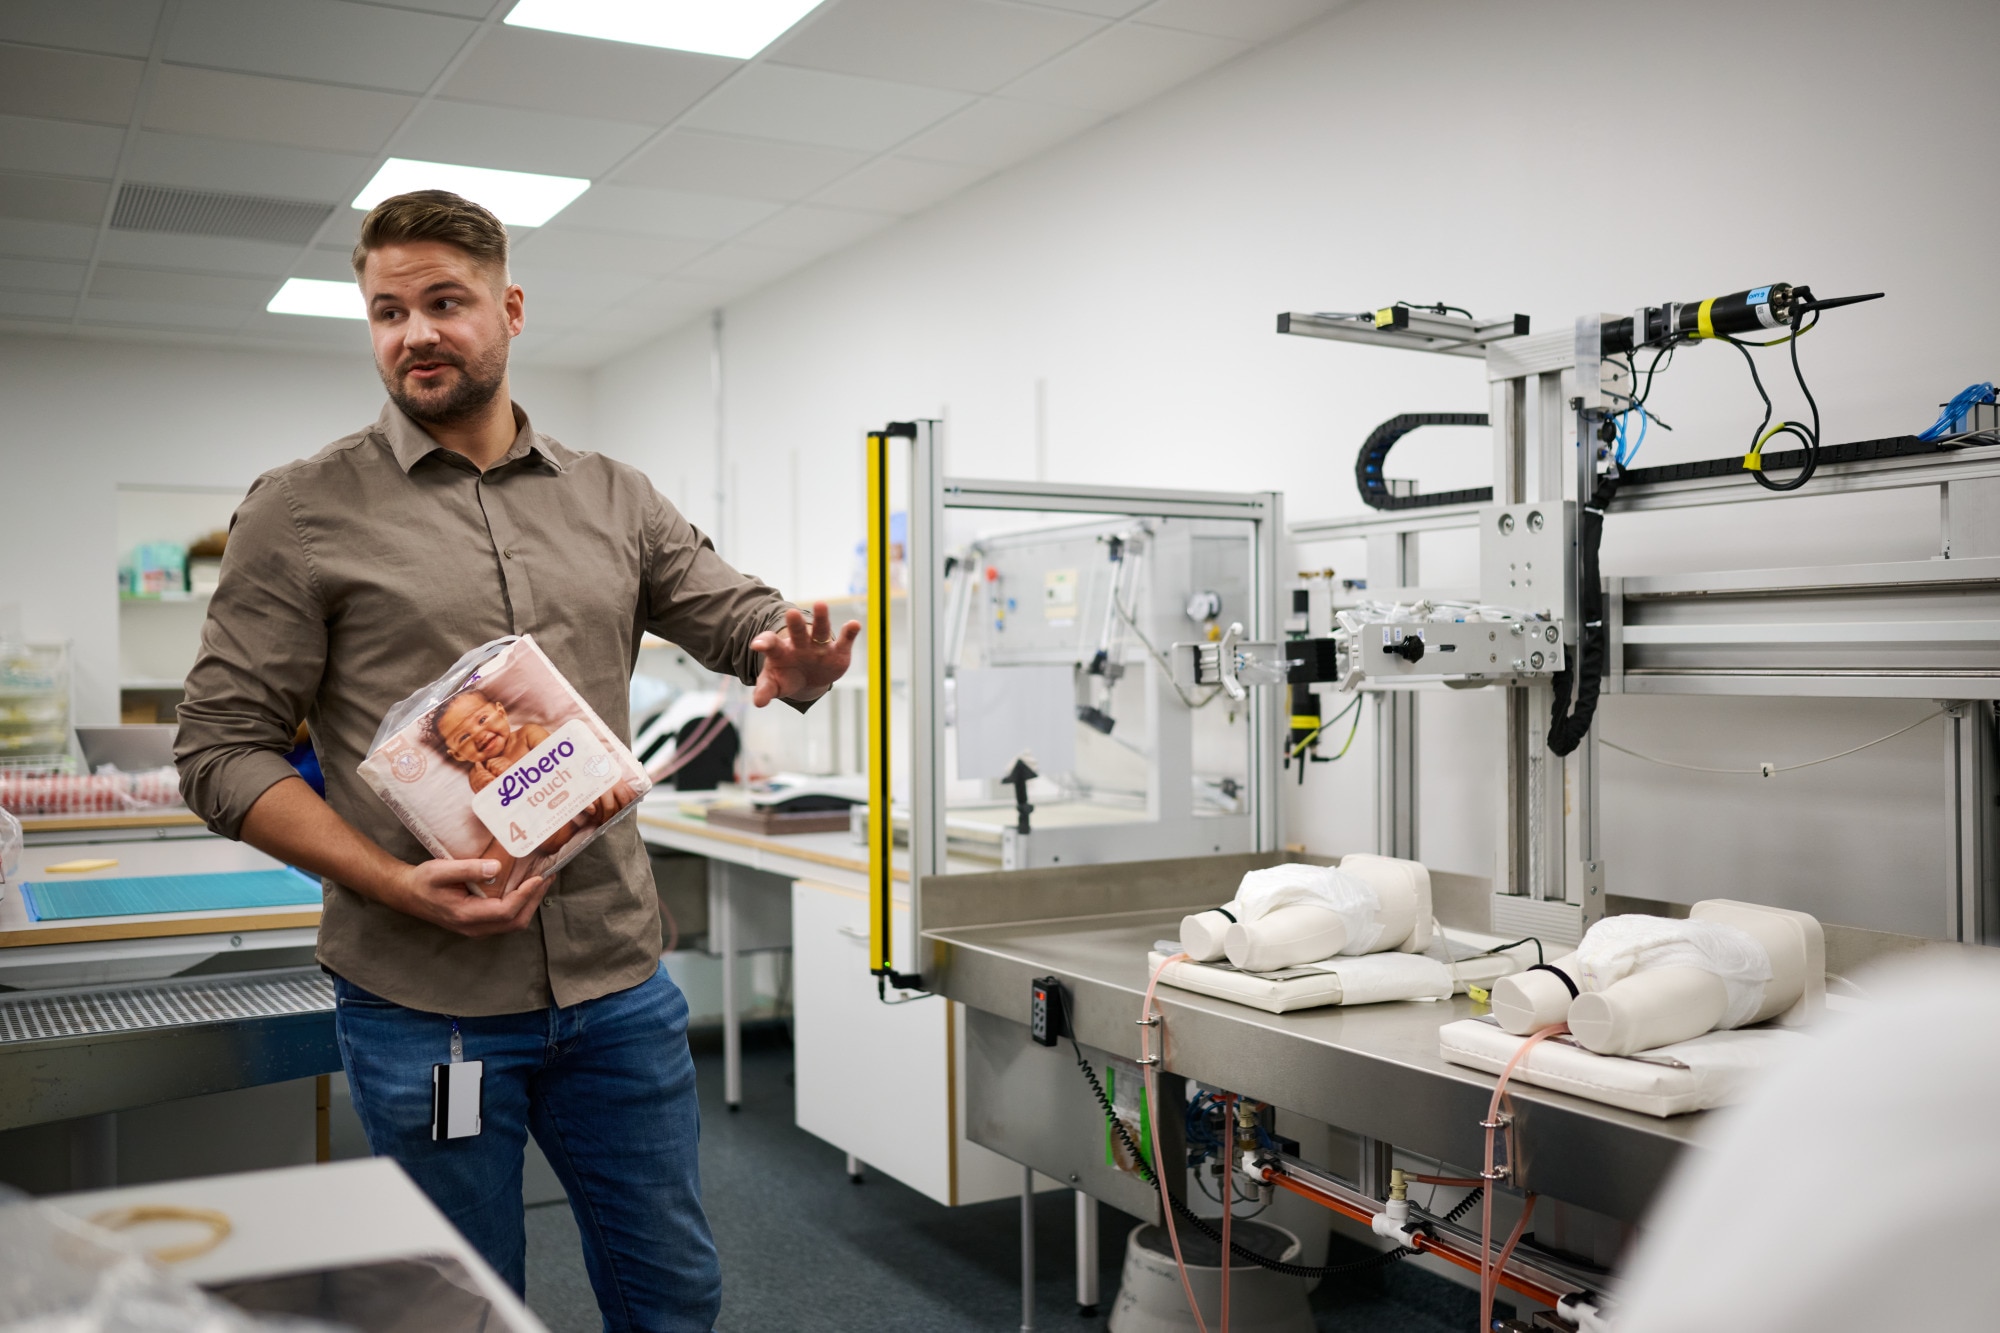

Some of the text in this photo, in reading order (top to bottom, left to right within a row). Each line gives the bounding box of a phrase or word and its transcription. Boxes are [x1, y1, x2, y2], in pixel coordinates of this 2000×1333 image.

[498, 741, 574, 807] Libero
[527, 769, 572, 808] touch
[509, 821, 528, 843] 4
